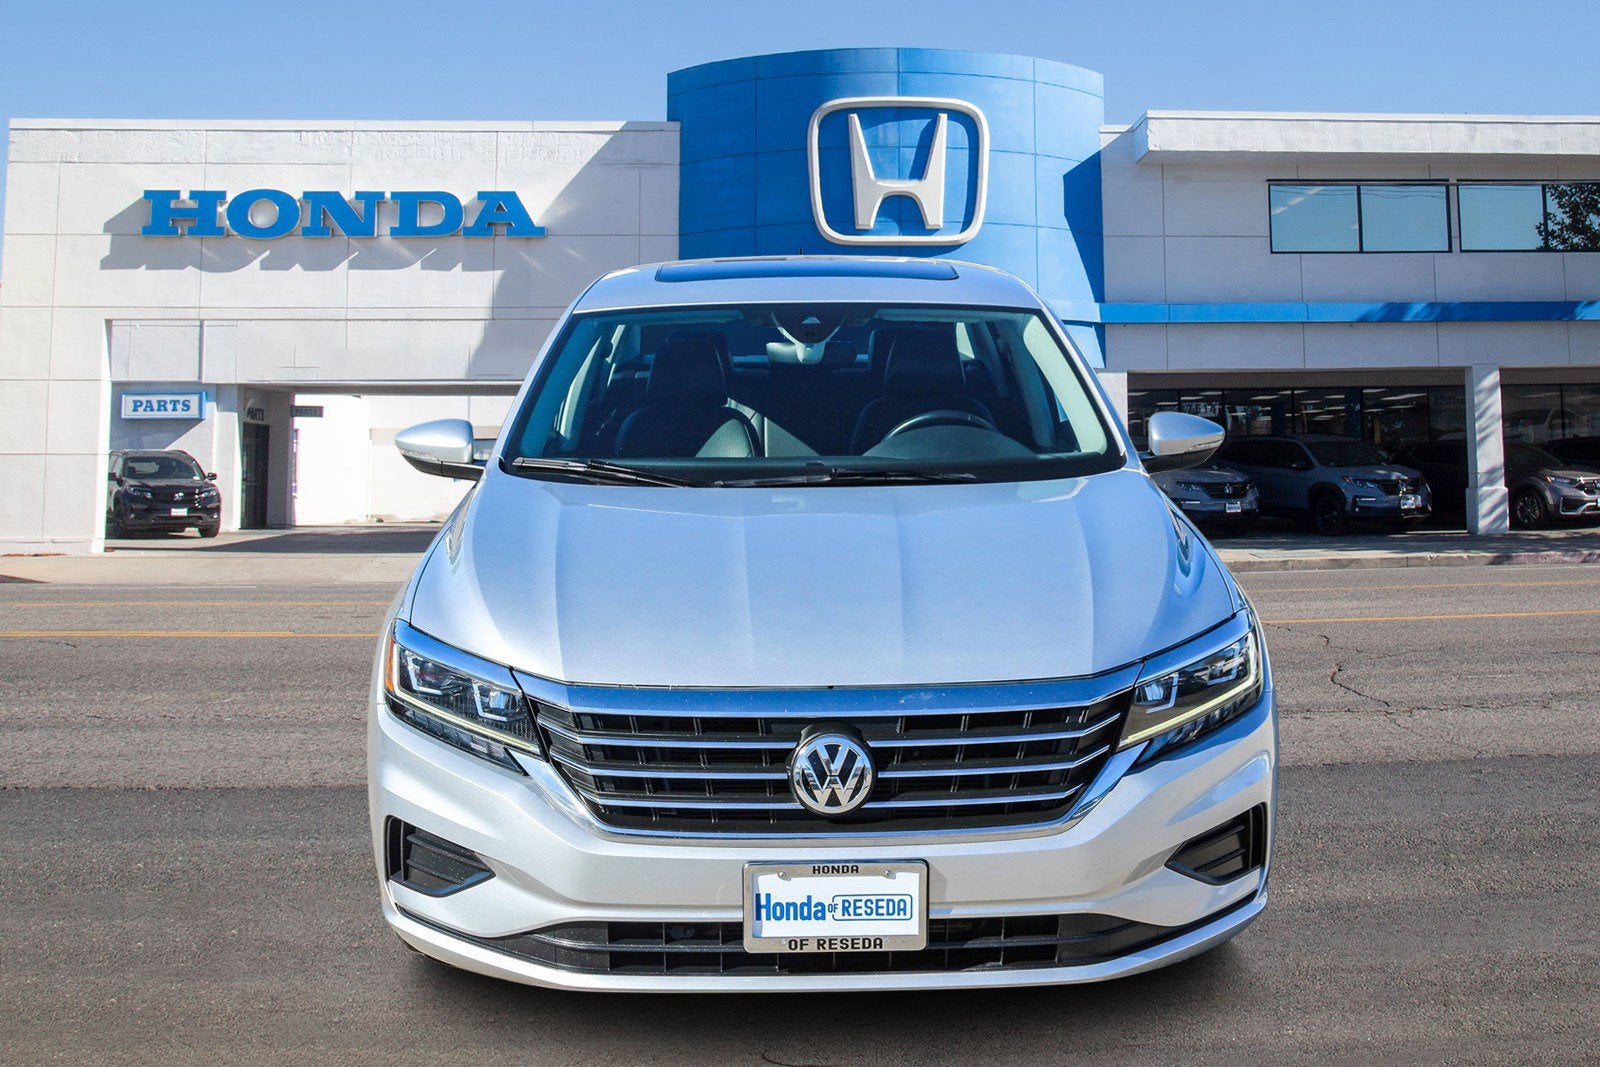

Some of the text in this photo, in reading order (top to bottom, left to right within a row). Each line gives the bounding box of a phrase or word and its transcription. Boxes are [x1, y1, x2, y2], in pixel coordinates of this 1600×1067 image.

[142, 189, 547, 239] HONDA
[132, 399, 191, 413] PARTS
[812, 864, 859, 875] HONDA
[755, 893, 907, 921] Honda OF RESEDA
[788, 937, 883, 950] OF RESEDA
